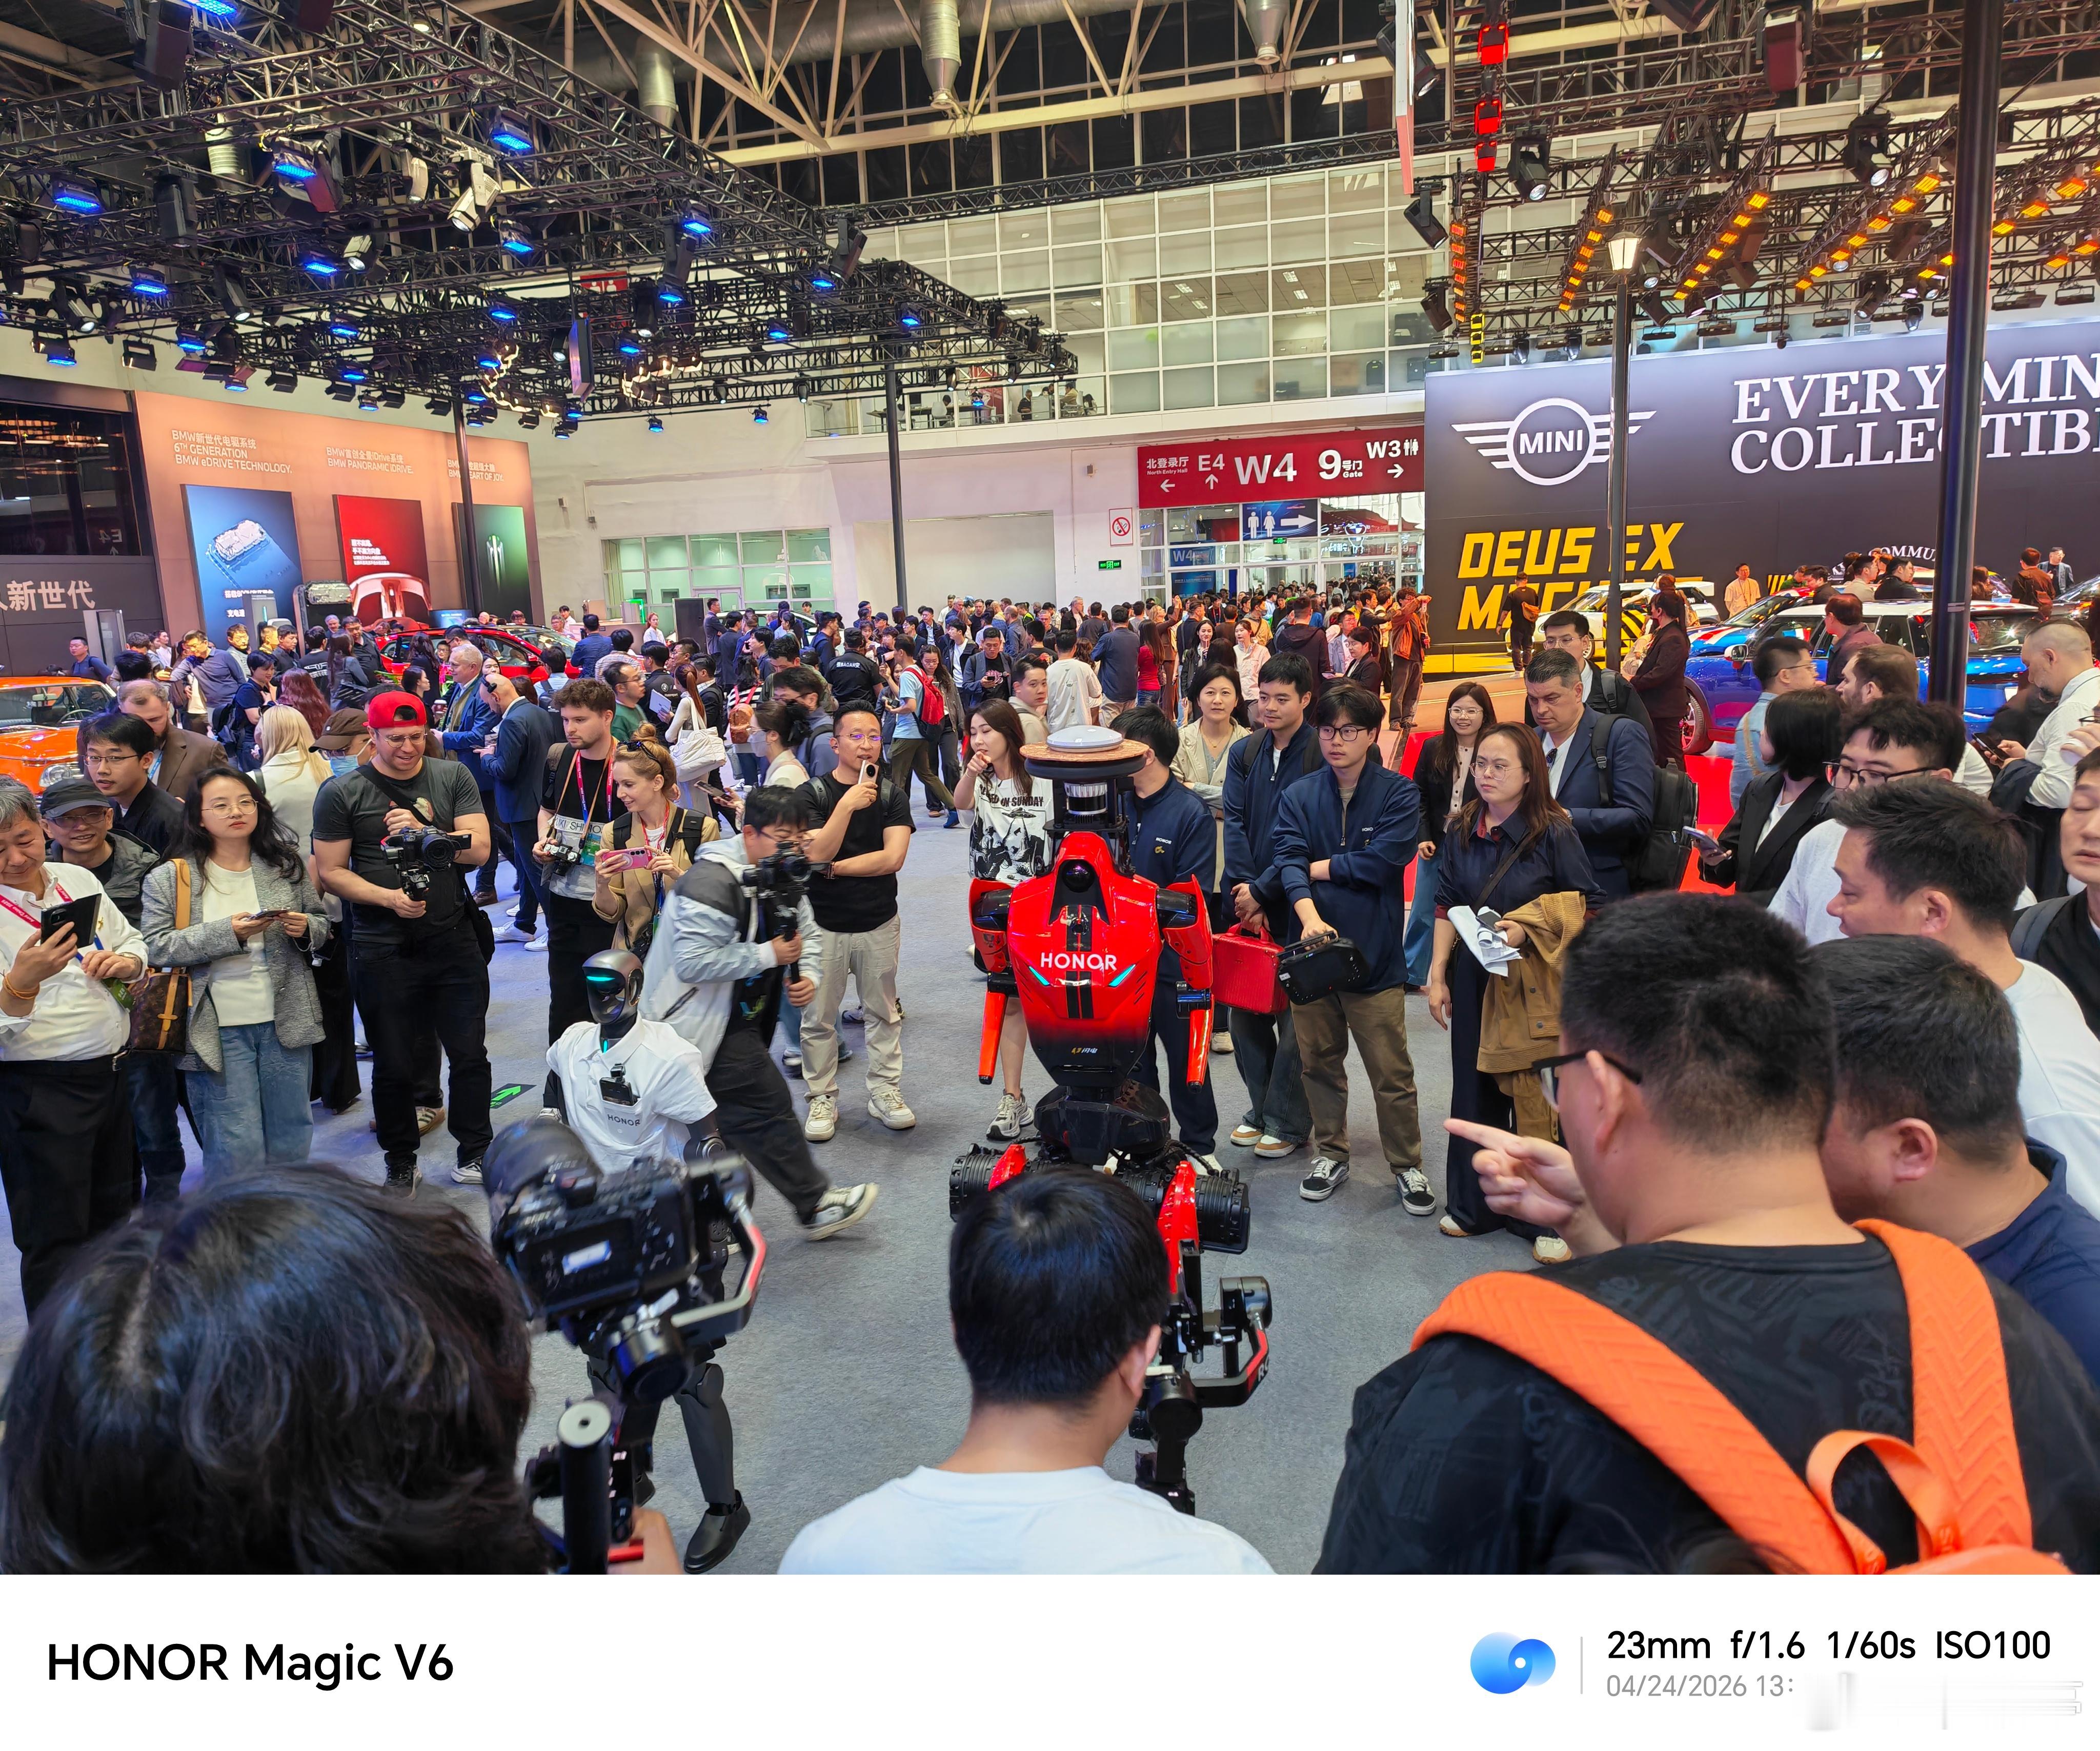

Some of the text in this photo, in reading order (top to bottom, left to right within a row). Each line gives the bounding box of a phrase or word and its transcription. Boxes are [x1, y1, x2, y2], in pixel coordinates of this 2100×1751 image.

[1732, 365, 1946, 423] EVERY
[1366, 440, 1401, 459] W3
[1519, 430, 1583, 455] MINI
[1731, 408, 2100, 474] COLLETIB
[174, 442, 248, 459] 6TH GENERATION
[175, 454, 293, 474] BMW eDRIVE TECHNOLOGY.
[328, 458, 346, 467] BMW
[348, 460, 390, 472] PANORAMIC
[1146, 456, 1189, 469] 北登录厅
[1198, 454, 1225, 472] E4
[1235, 452, 1297, 484] W4
[1319, 450, 1363, 480] 9 号门
[469, 471, 484, 480] EART
[484, 472, 493, 481] OF
[1173, 549, 1193, 562] W4
[1458, 527, 1596, 578] DEUS
[1868, 545, 1936, 561] OMMU
[0, 580, 96, 612] 新世代
[1011, 796, 1044, 807] SUNDAY
[1041, 952, 1117, 970] HONOR
[608, 1113, 640, 1126] HONOR
